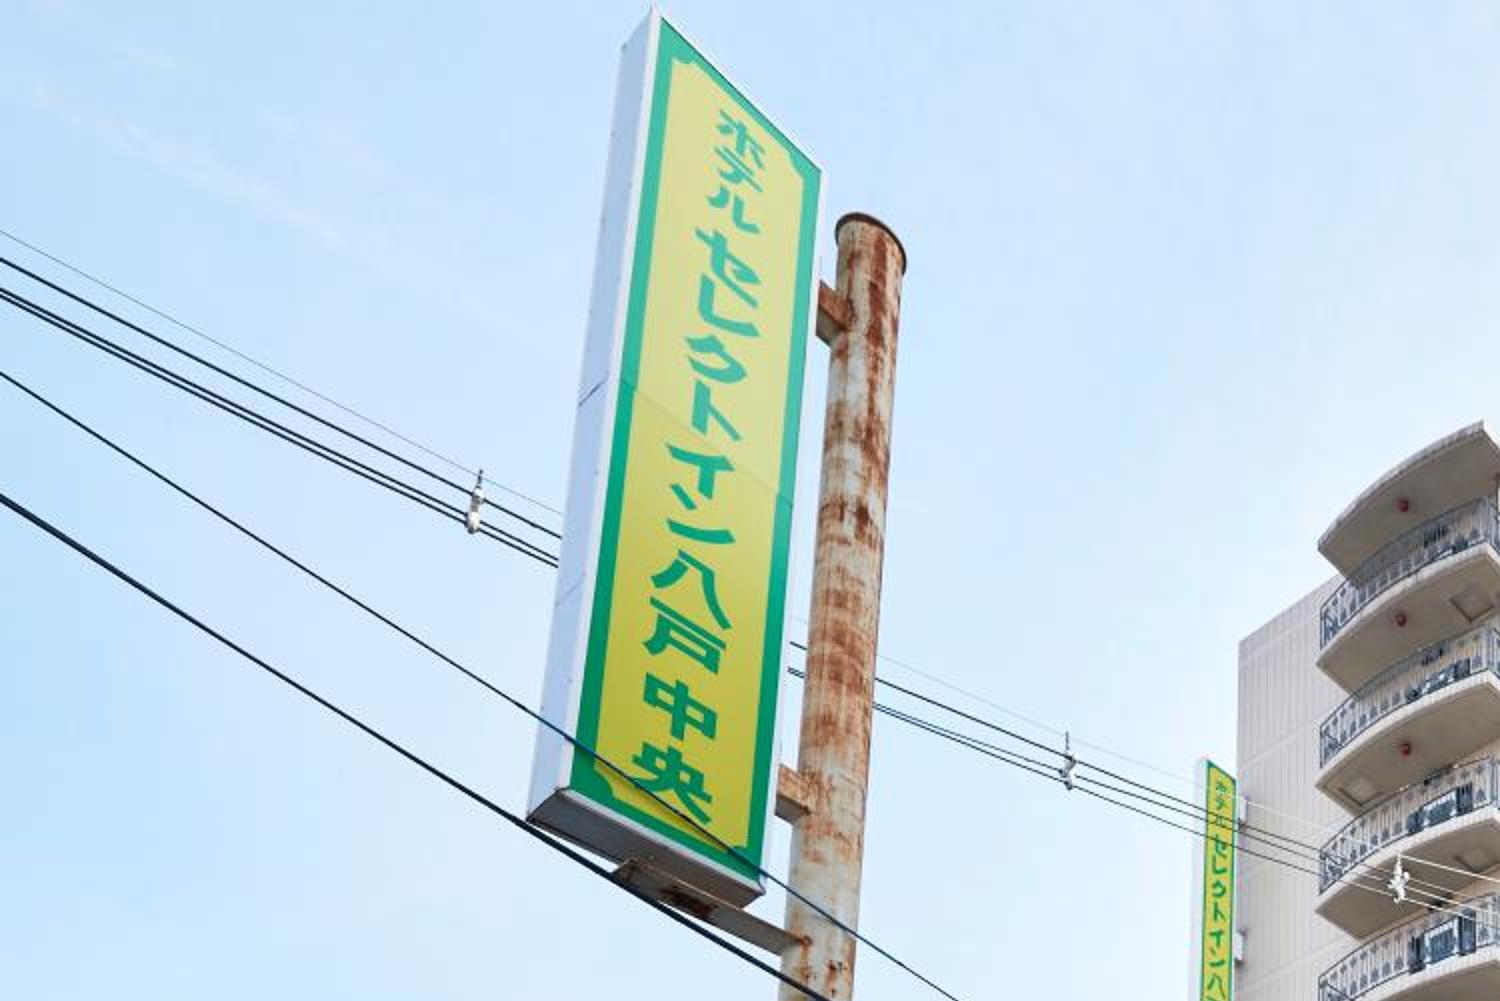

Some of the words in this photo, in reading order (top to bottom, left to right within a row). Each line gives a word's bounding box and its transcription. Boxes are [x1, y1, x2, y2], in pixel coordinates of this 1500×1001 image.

[631, 108, 766, 827] ホテルセレクトイン八戸中央
